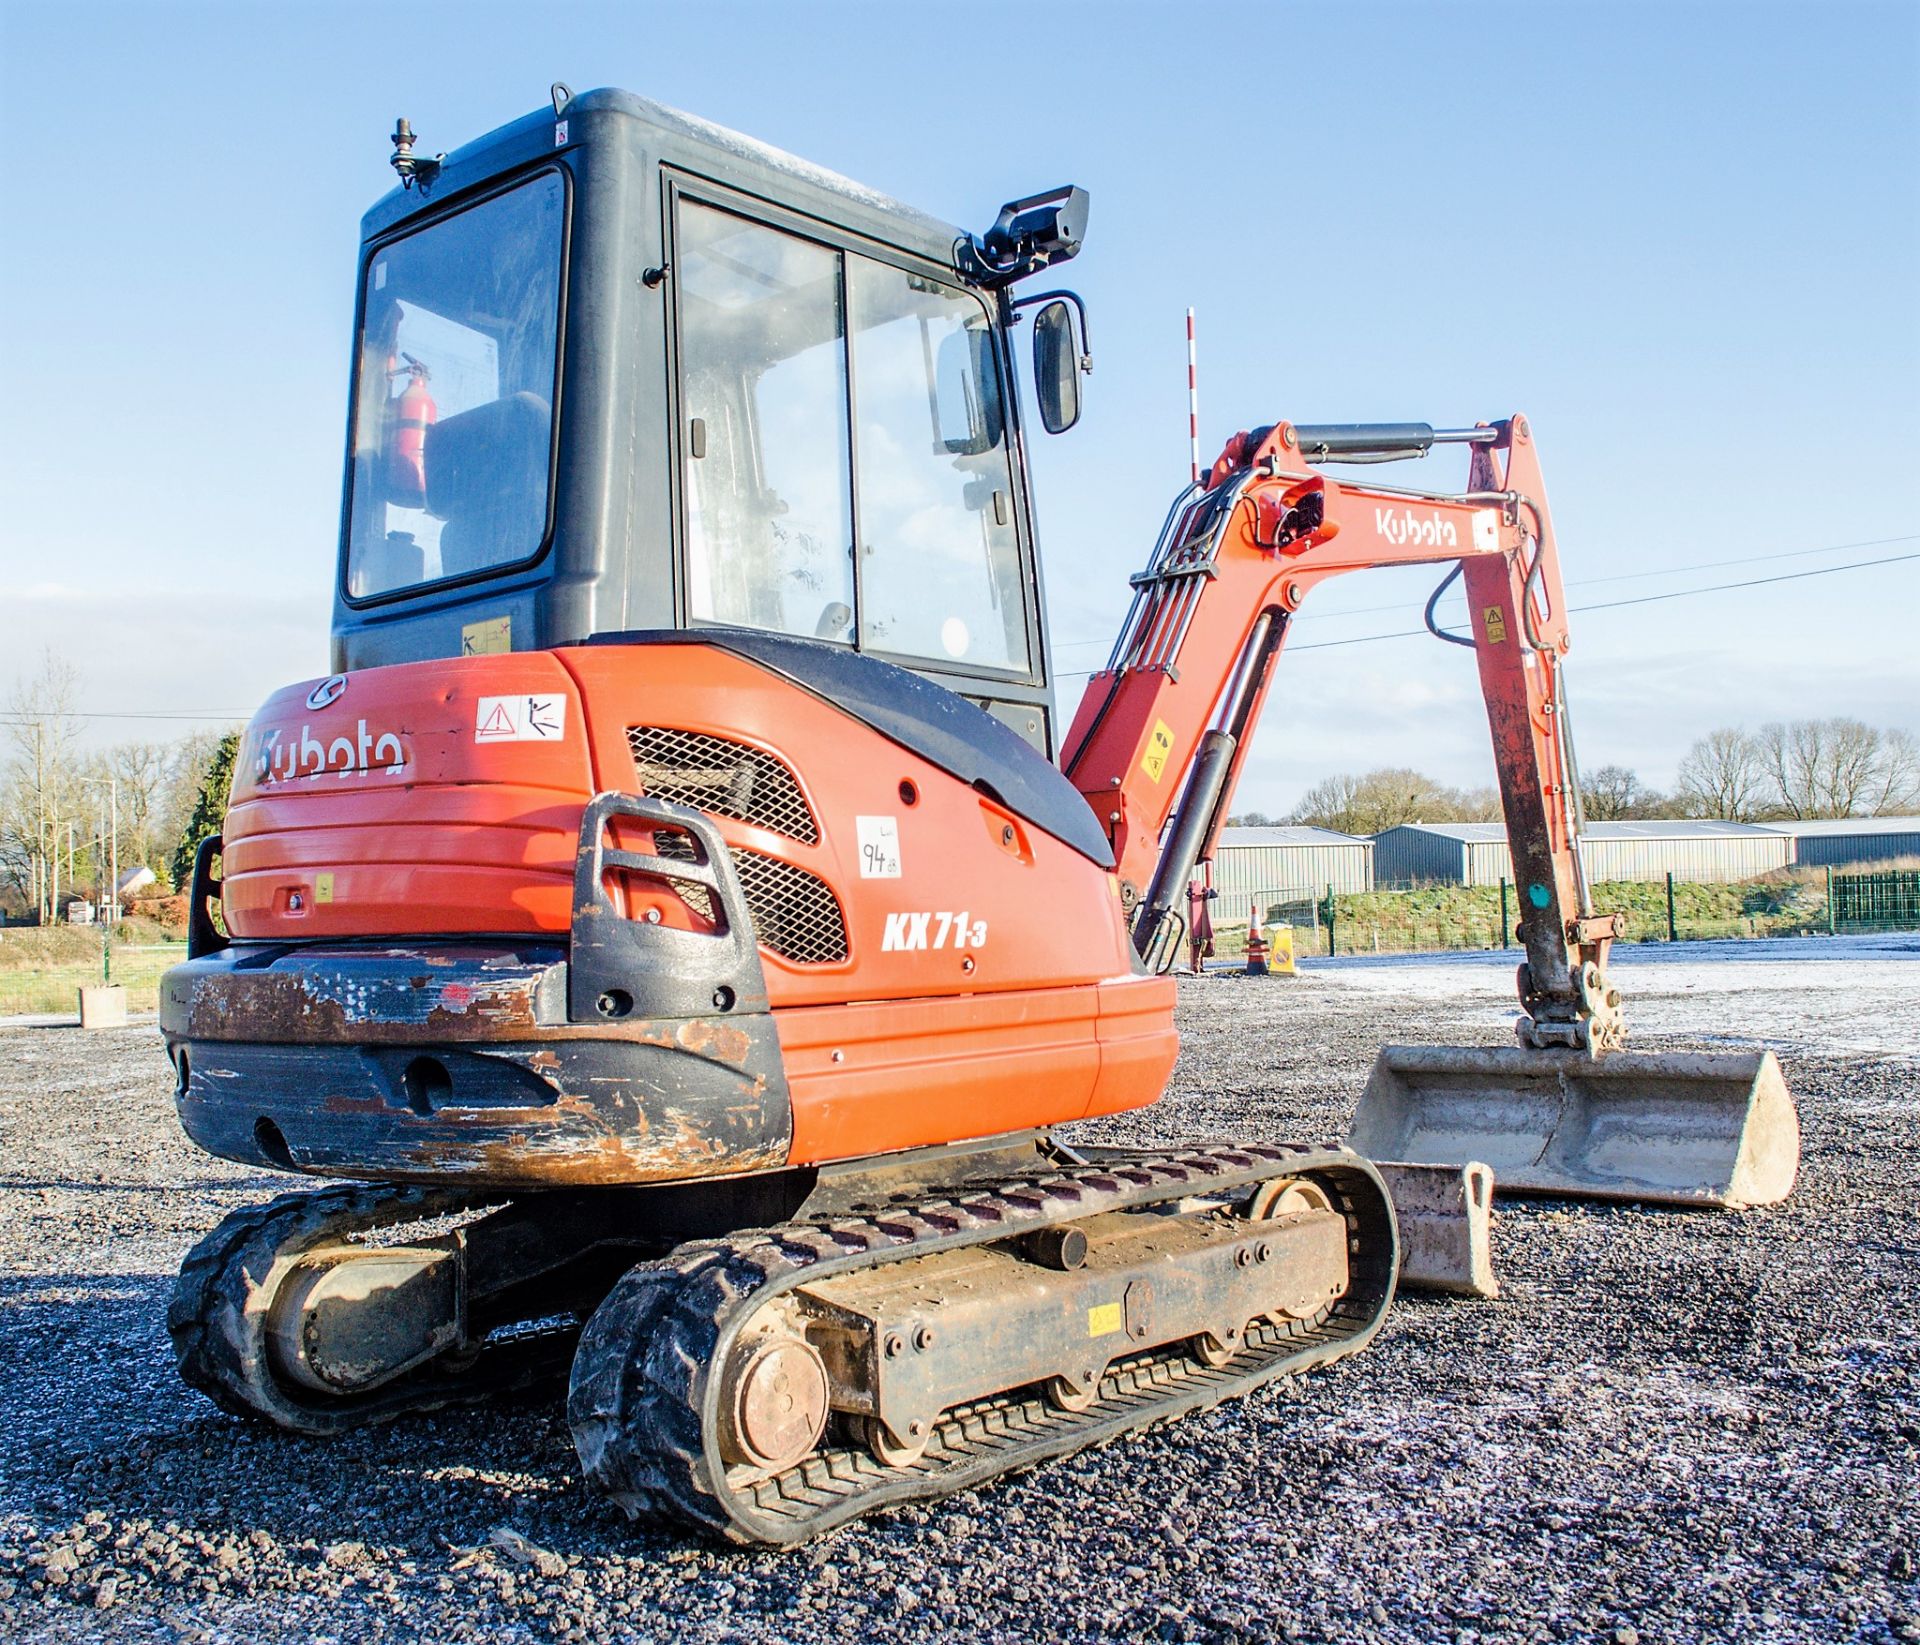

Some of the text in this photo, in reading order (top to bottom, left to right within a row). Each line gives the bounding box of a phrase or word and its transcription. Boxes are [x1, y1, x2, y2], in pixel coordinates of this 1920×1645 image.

[1375, 507, 1457, 546] Kubota
[255, 719, 403, 784] Kubota
[863, 843, 886, 873] 94
